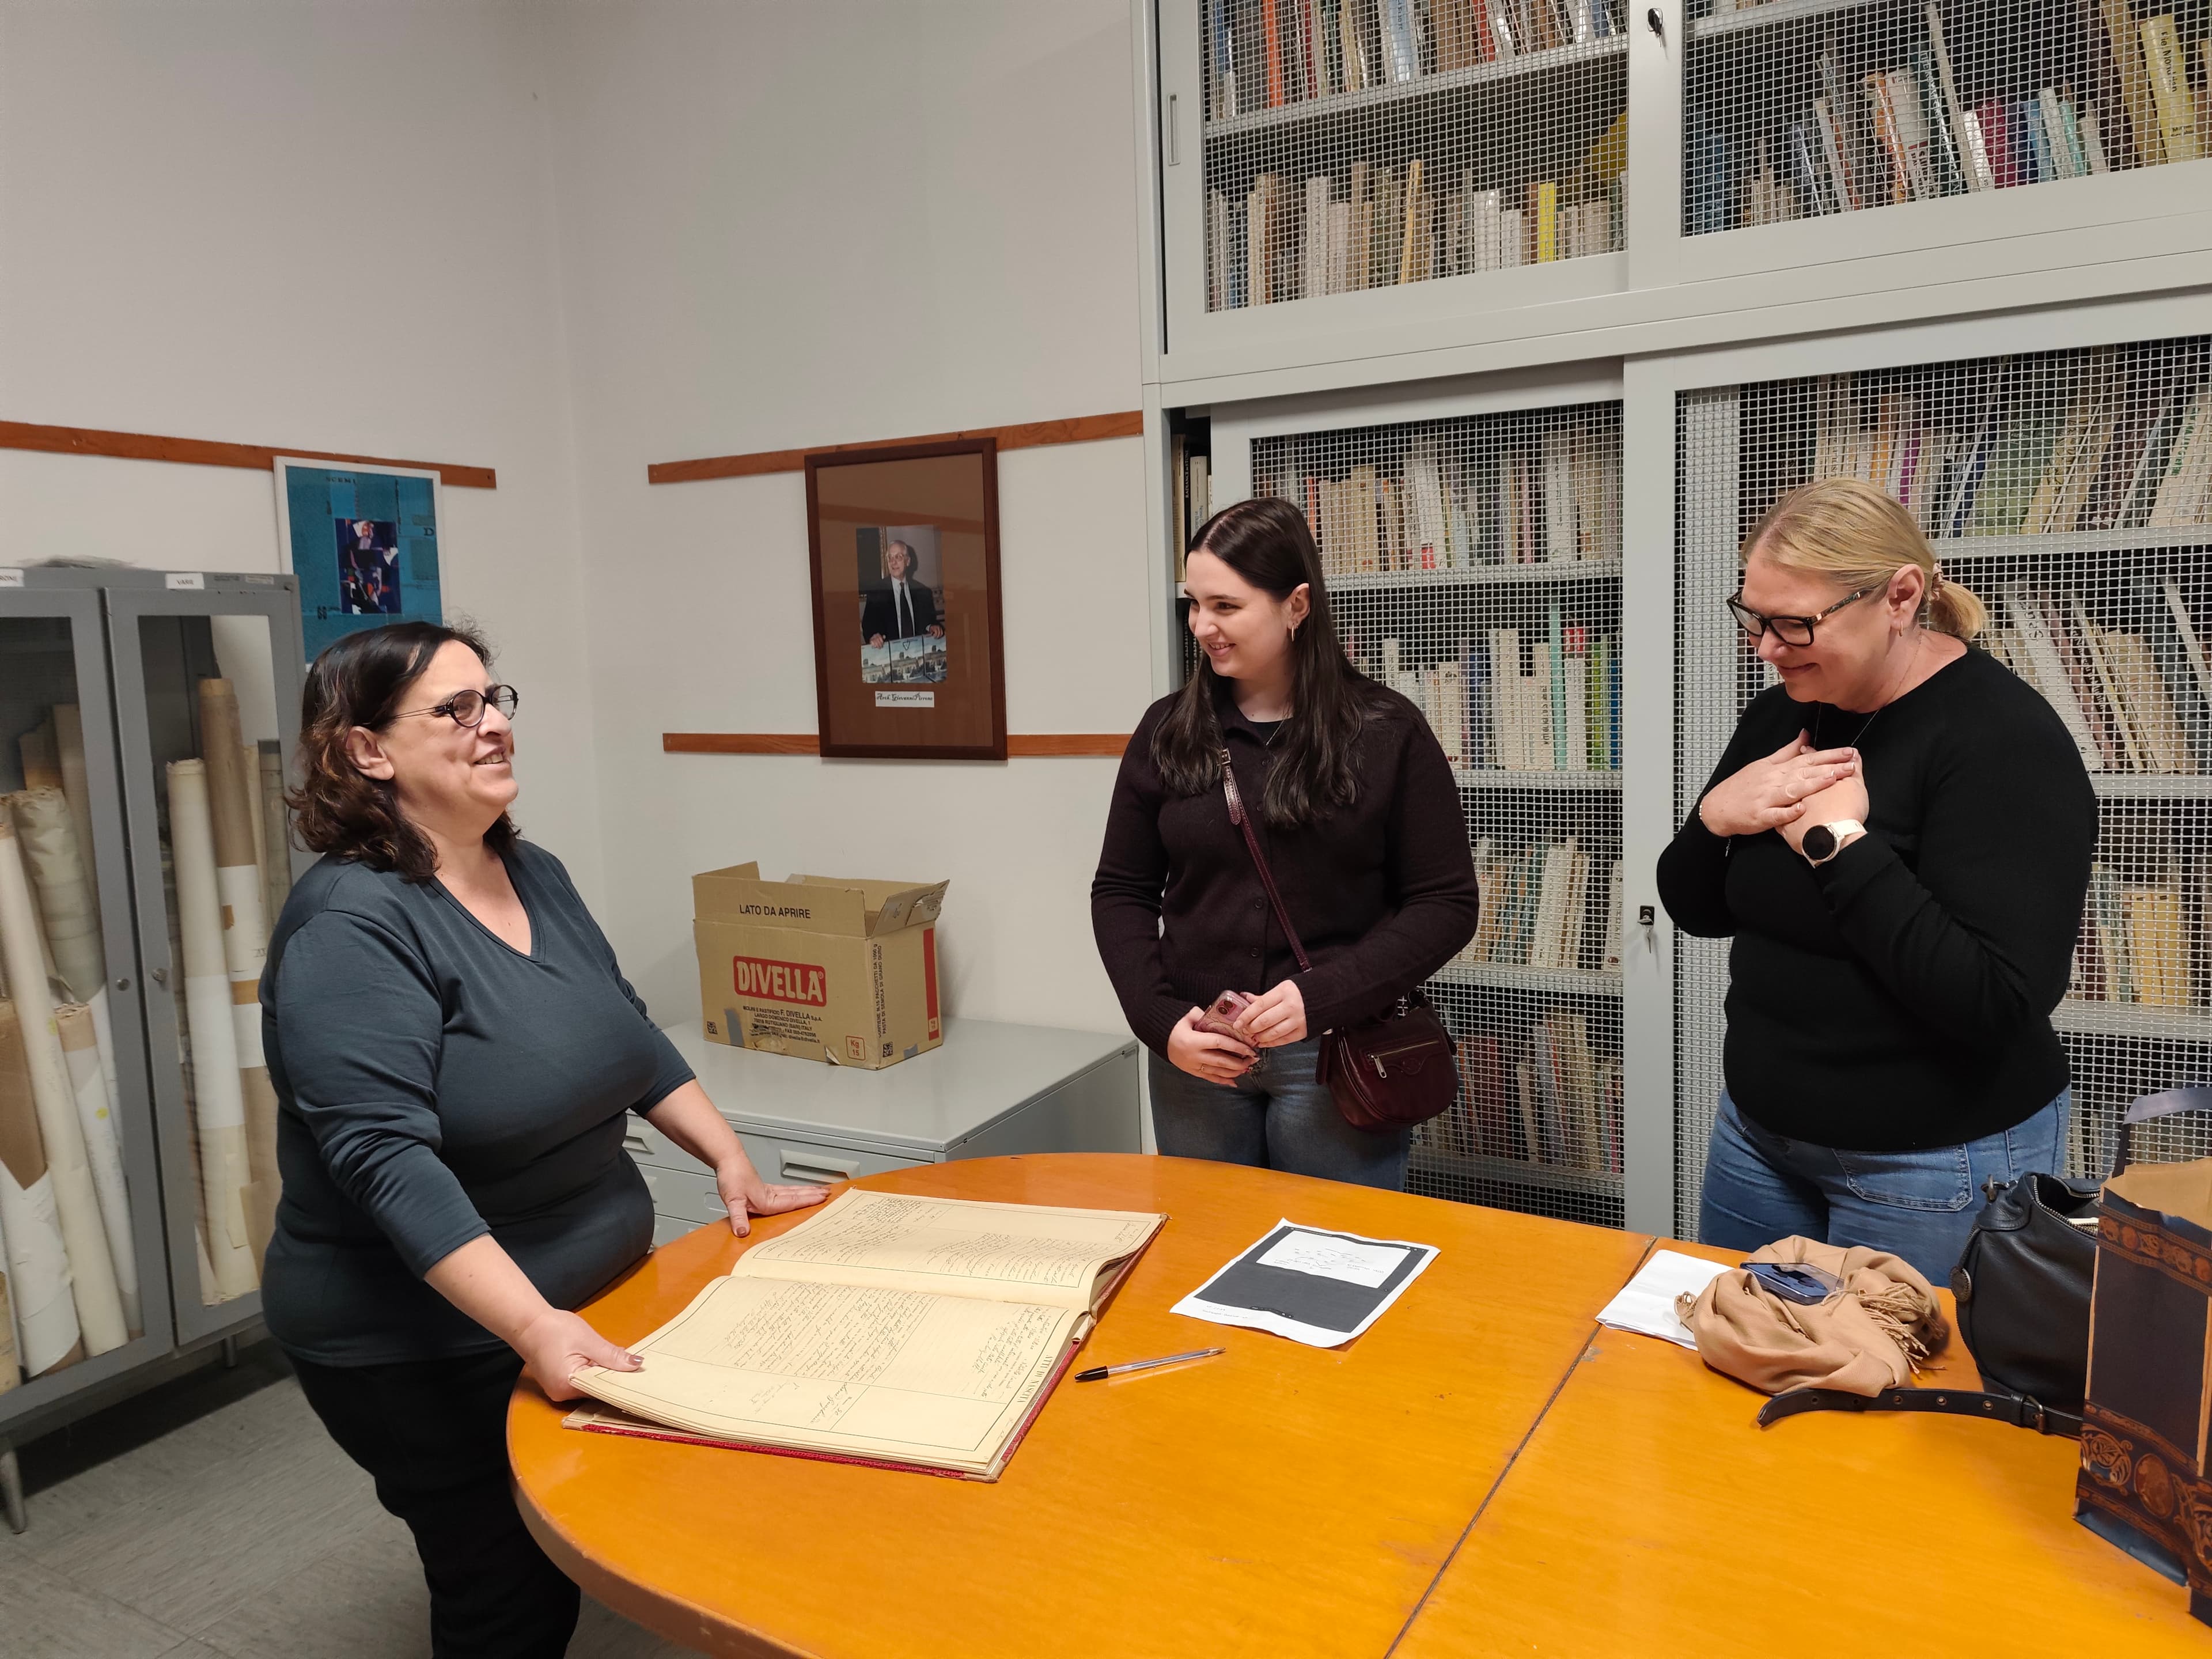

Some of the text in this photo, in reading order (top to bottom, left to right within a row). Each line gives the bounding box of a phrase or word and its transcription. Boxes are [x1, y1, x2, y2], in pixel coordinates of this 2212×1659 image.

[740, 904, 811, 918] LATO DA APRIRE
[736, 961, 823, 1002] DIVELLA
[786, 1010, 810, 1020] DIVELLA
[851, 1040, 859, 1048] Kg
[1040, 1355, 1054, 1368] ATTI
[1017, 1380, 1039, 1403] NASCITA
